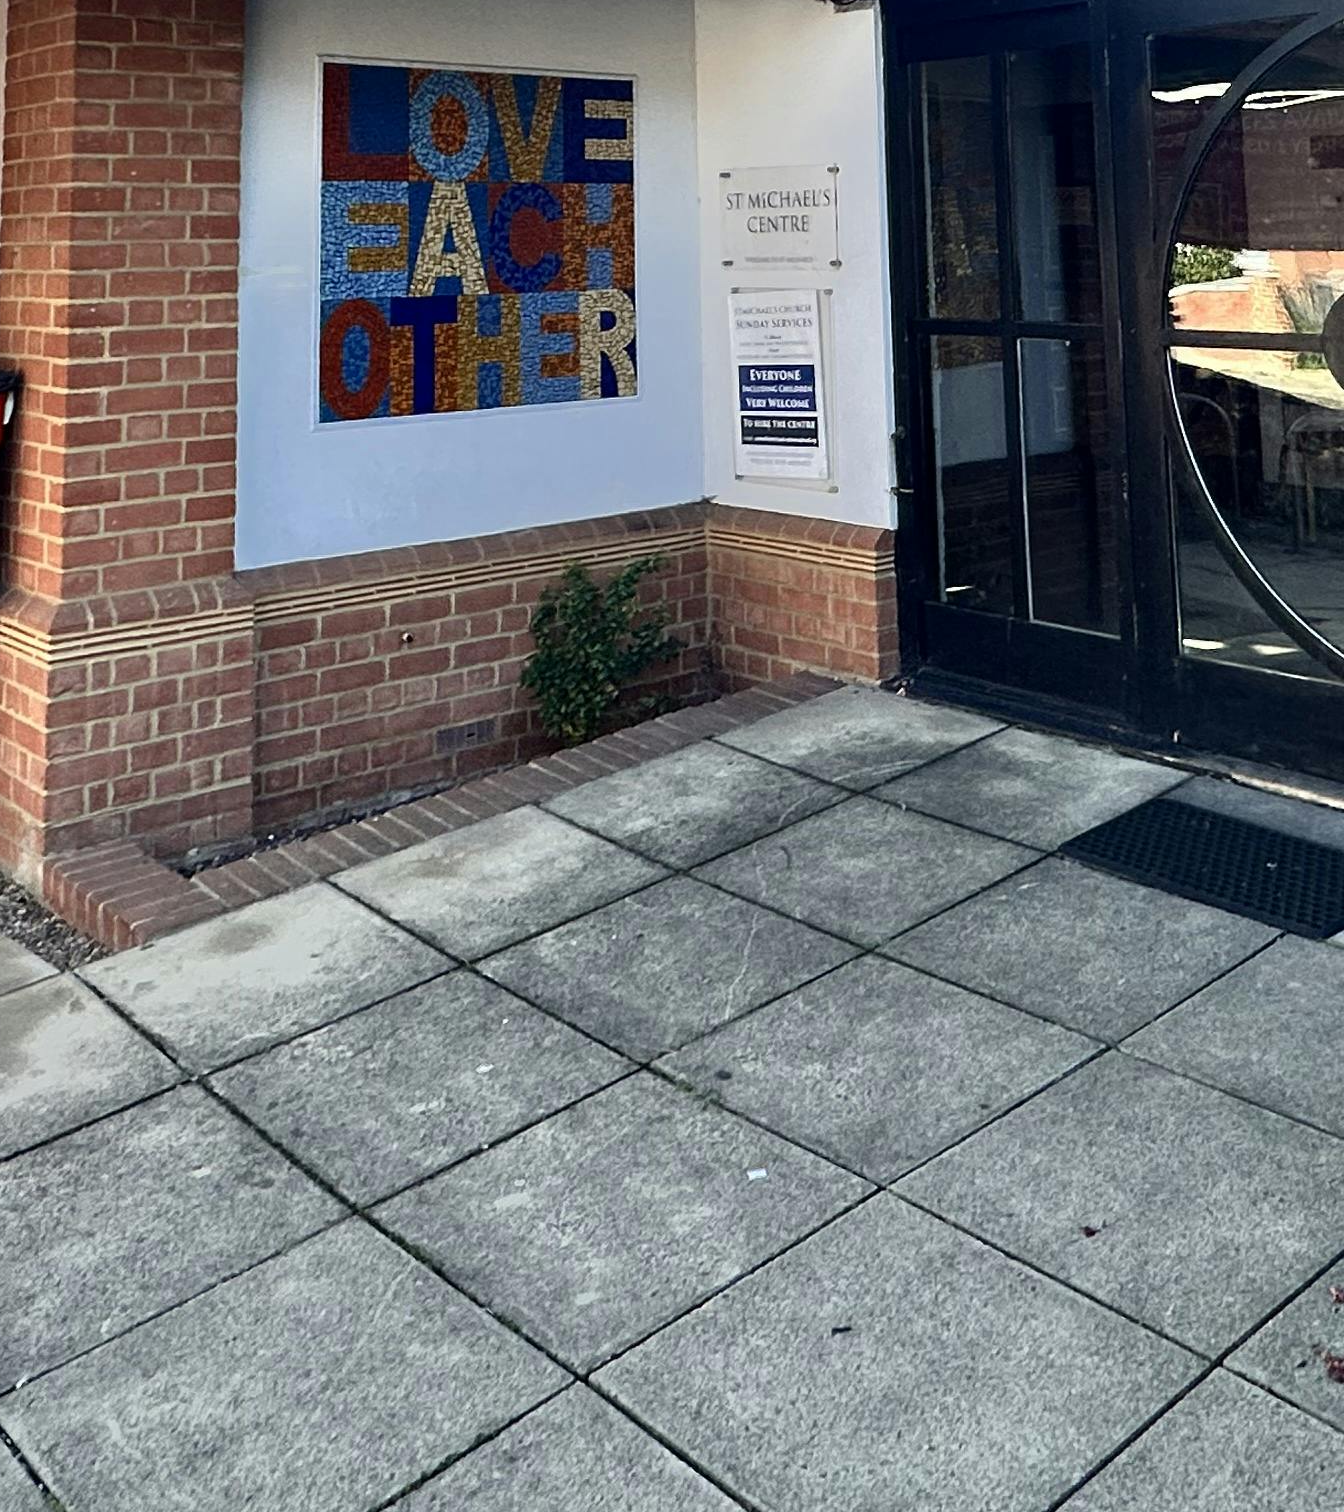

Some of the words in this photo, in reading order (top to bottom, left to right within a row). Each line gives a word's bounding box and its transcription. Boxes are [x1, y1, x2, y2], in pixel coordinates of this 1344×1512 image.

[323, 66, 633, 181] LOVE
[726, 192, 745, 210] ST
[747, 215, 809, 233] CENTRE
[320, 180, 634, 297] EACH
[771, 318, 813, 328] SERVICES
[321, 287, 638, 420] OTHER
[750, 369, 801, 381] EVERYONE
[768, 398, 809, 408] WELCOME
